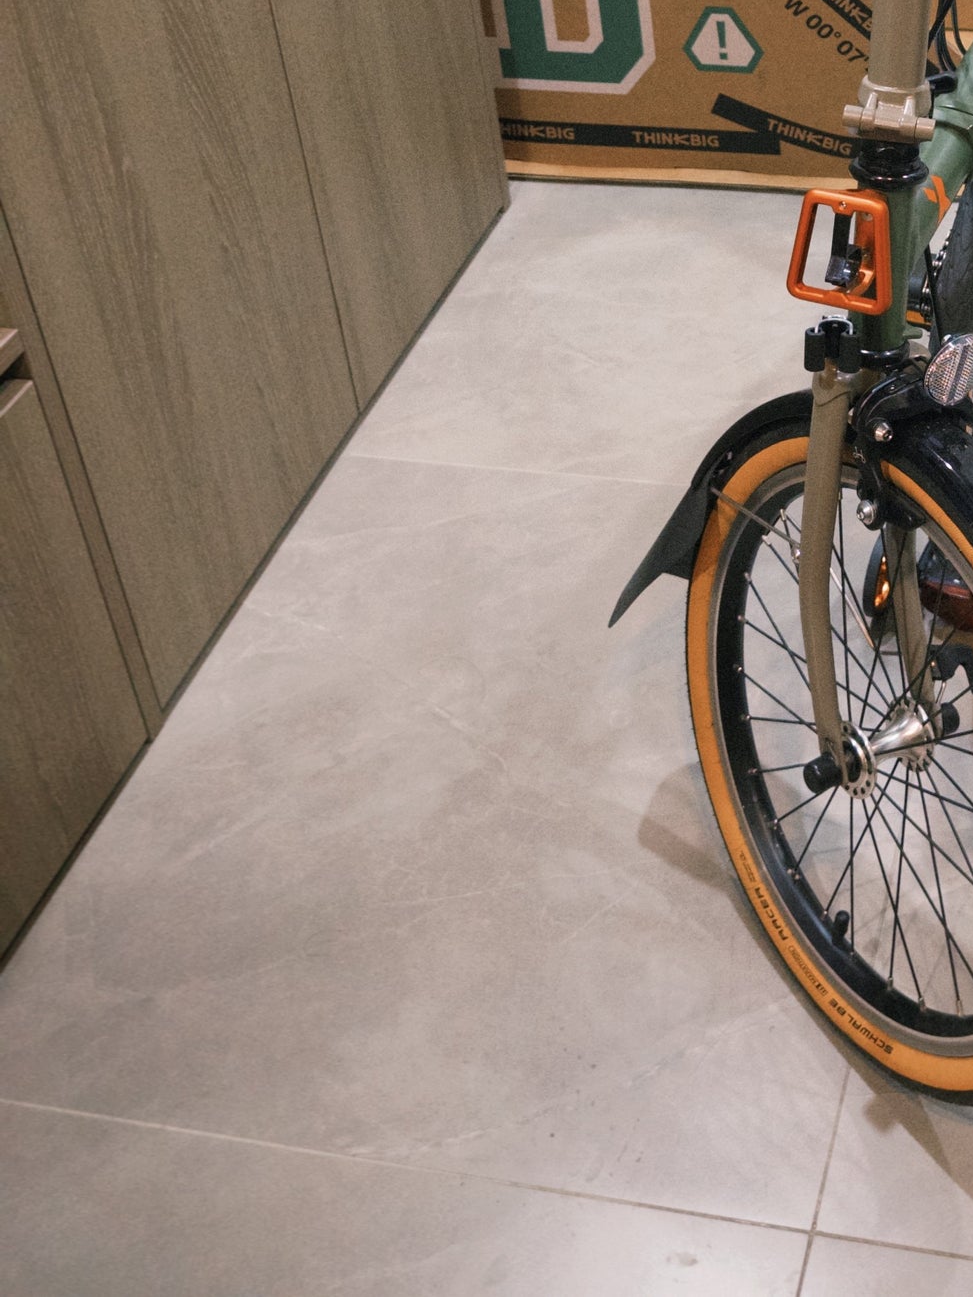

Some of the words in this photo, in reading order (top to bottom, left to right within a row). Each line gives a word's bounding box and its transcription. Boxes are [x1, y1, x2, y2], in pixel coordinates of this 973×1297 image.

[501, 122, 575, 141] HINKBIG
[754, 887, 789, 941] RACER
[828, 998, 894, 1055] SCHWALBE
